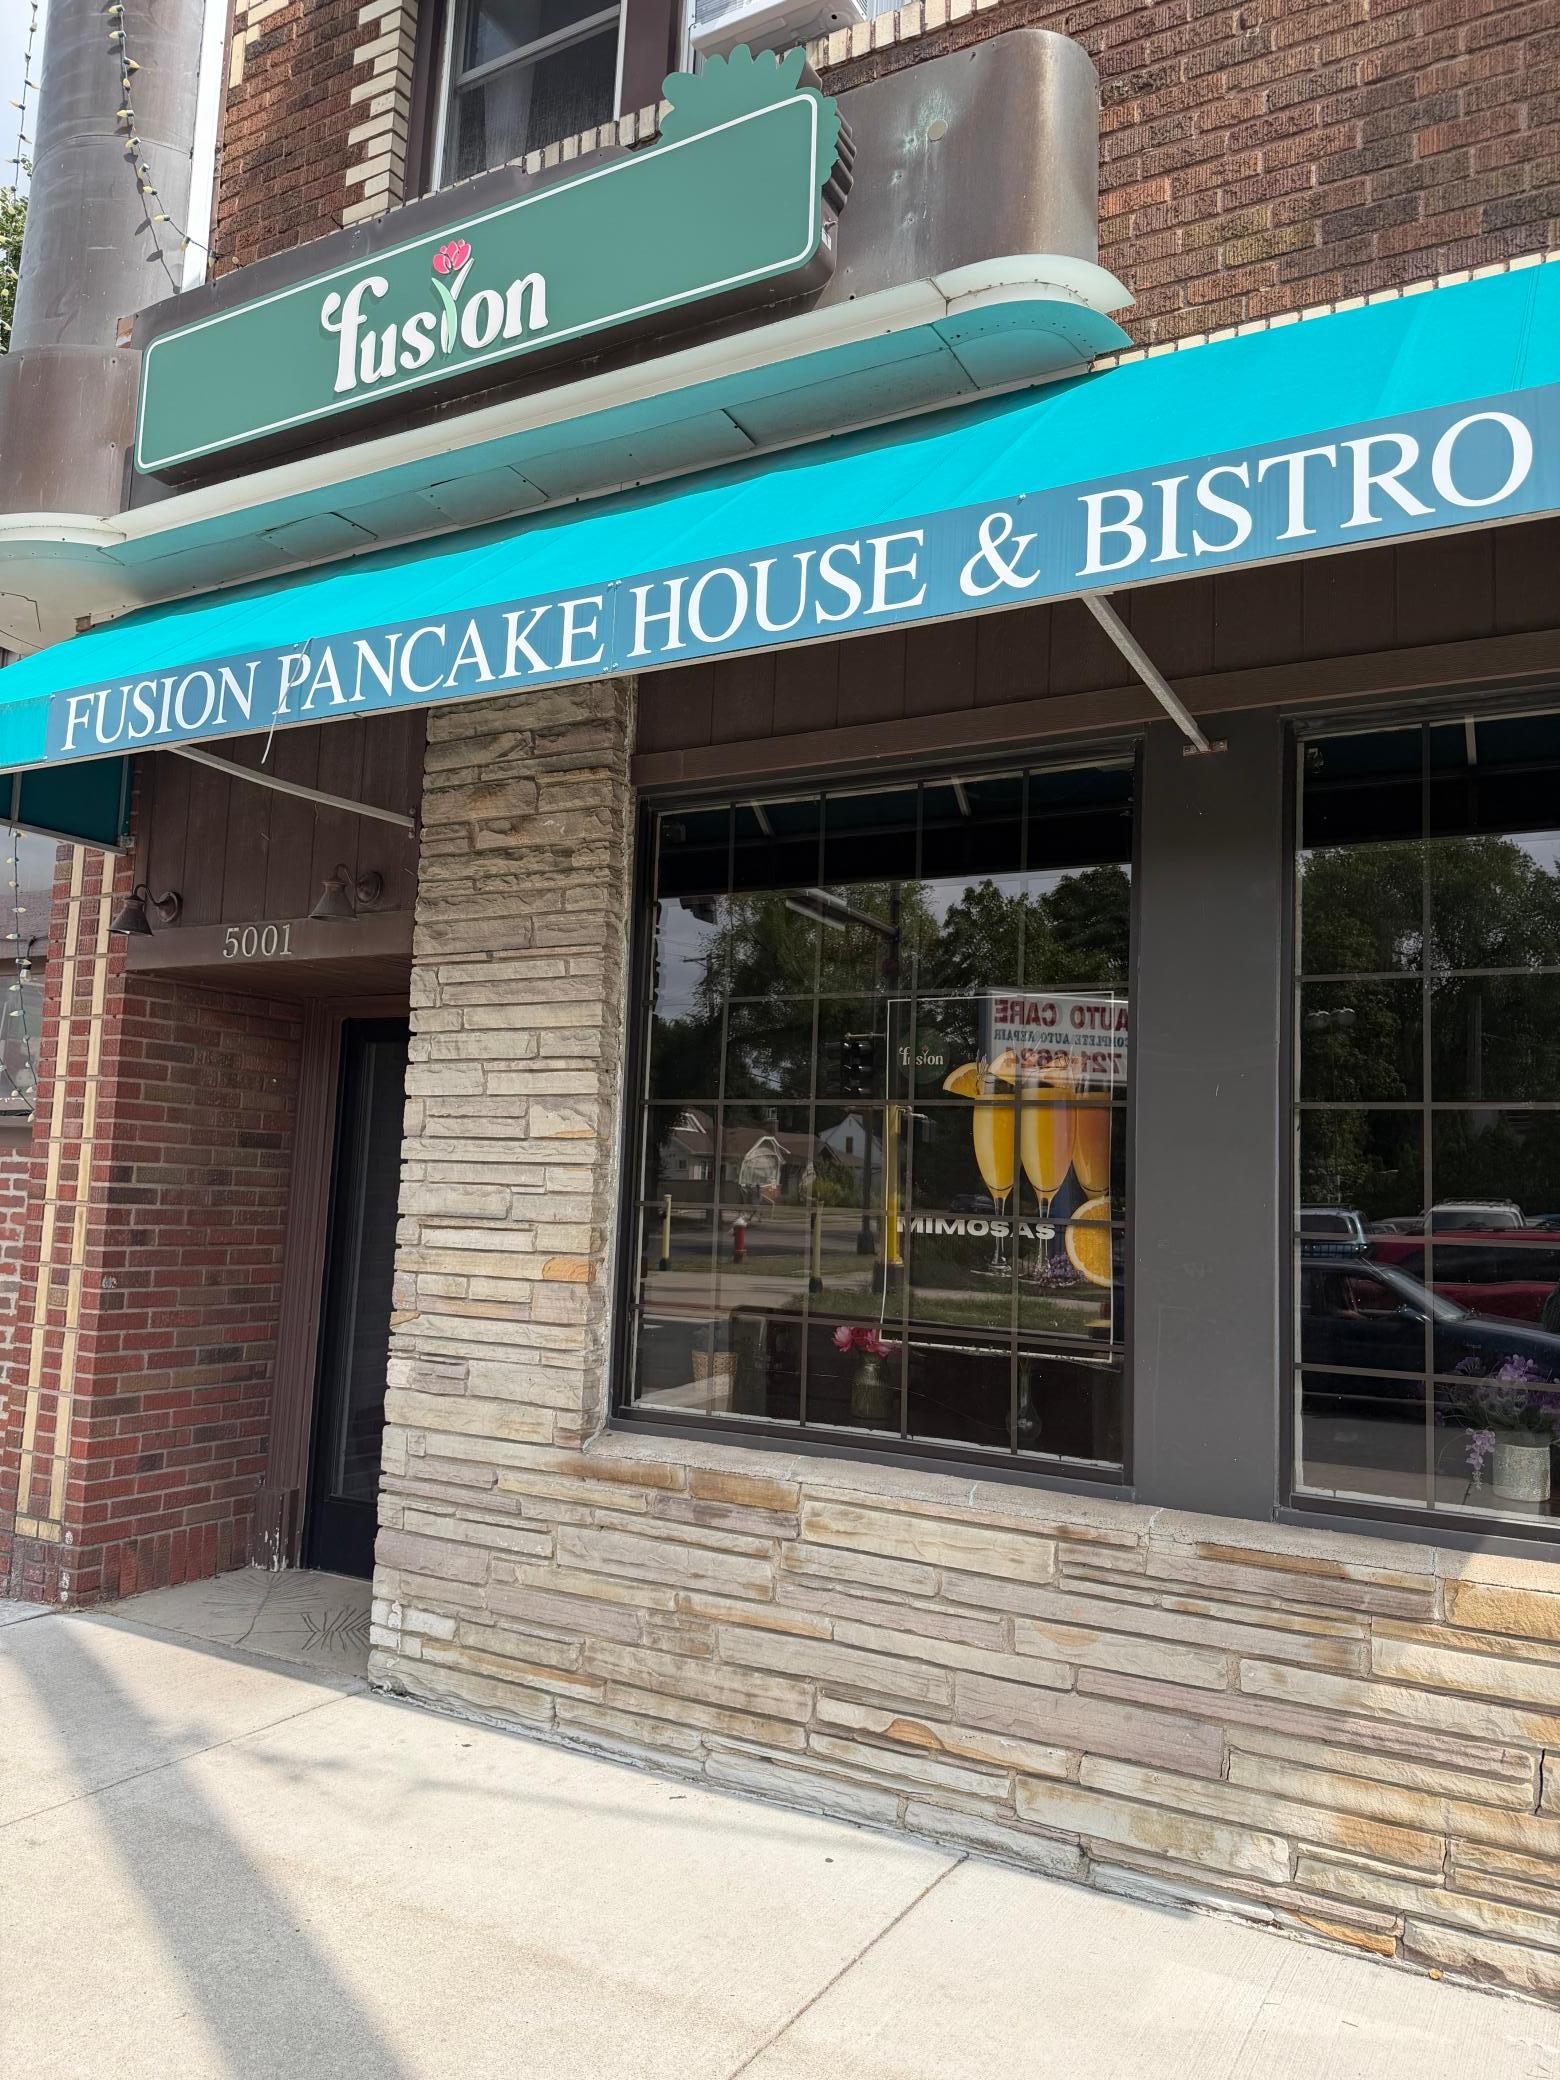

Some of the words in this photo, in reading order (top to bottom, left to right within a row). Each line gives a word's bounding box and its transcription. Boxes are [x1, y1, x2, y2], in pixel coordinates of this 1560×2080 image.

[320, 256, 549, 395] fusion
[60, 660, 261, 751] FUSION
[273, 595, 605, 715] PANCAKE
[626, 528, 928, 658] HOUSE
[959, 511, 1041, 598] &
[1075, 411, 1535, 577] BISTRO
[222, 923, 292, 958] 5001
[896, 1216, 1056, 1240] MIMOSAS
